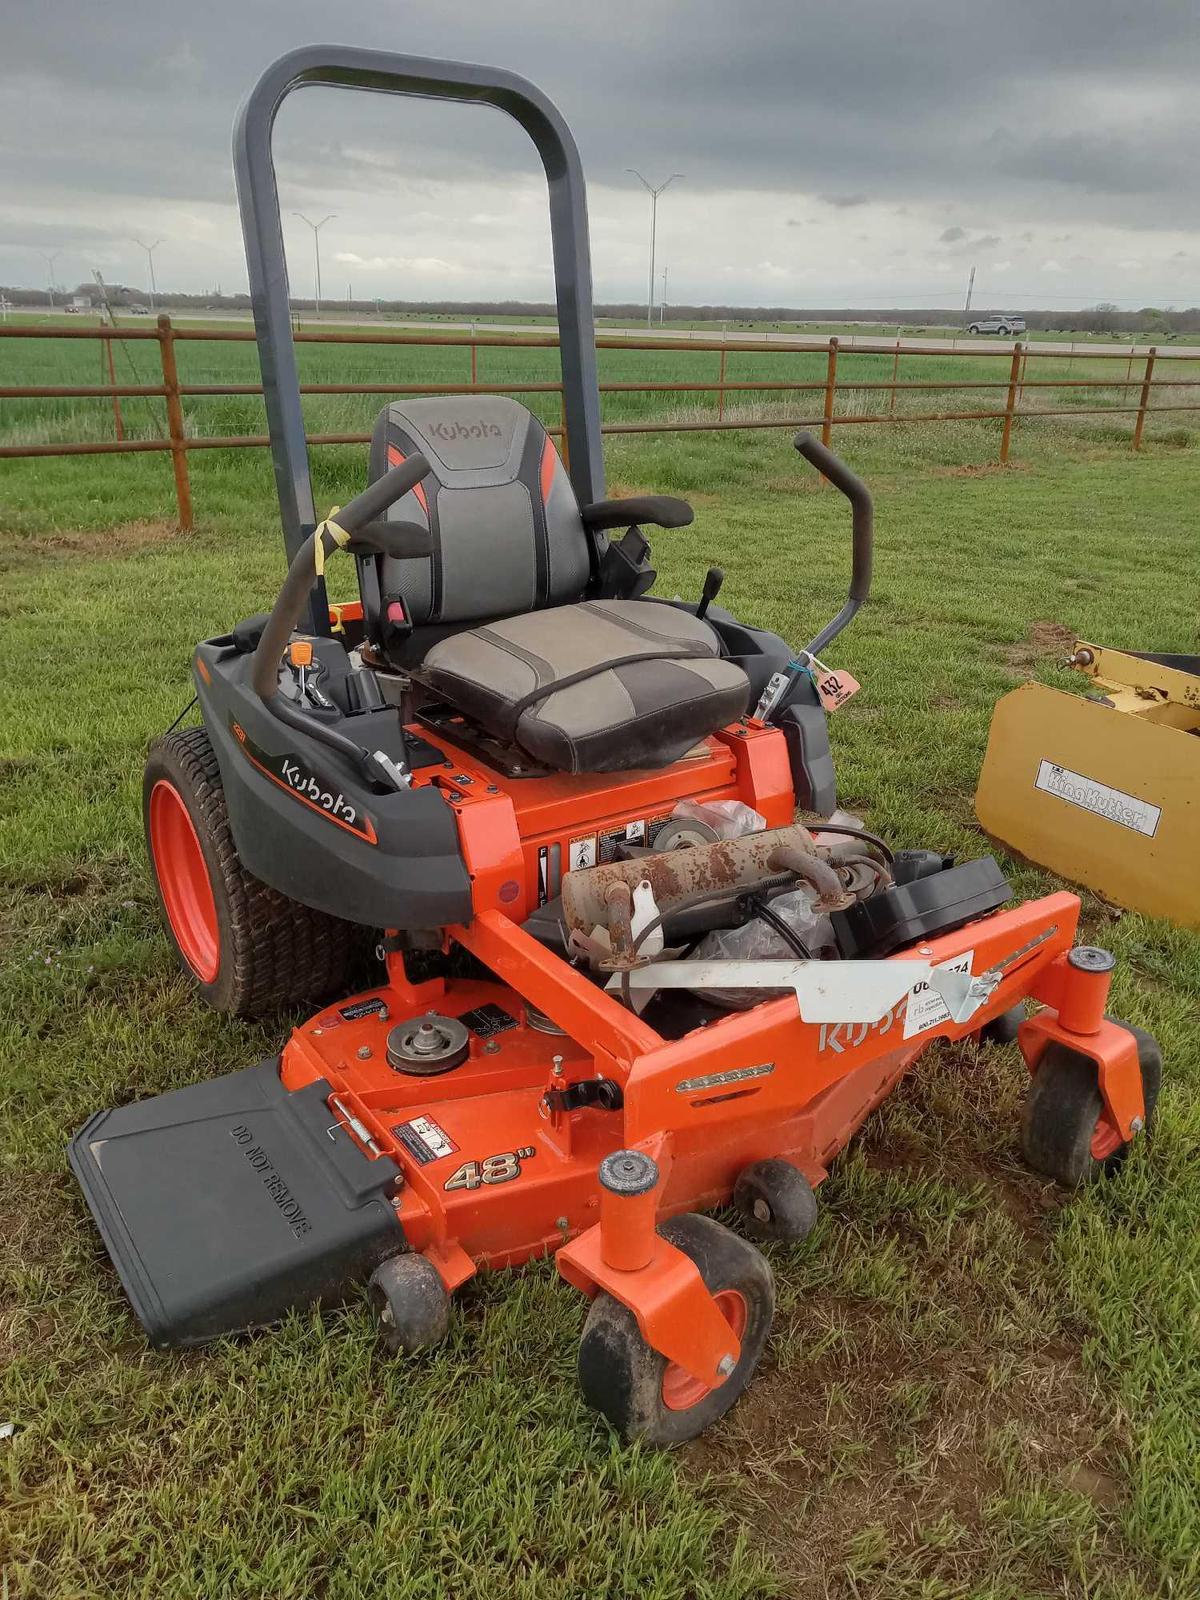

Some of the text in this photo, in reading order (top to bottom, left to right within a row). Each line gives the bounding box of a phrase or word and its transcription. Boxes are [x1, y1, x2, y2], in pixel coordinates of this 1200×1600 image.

[428, 420, 503, 441] Kubota
[820, 676, 844, 697] 432
[281, 759, 356, 824] Kubota
[231, 1124, 312, 1239] DO NOT REMOVE
[444, 1147, 536, 1191] 48"
